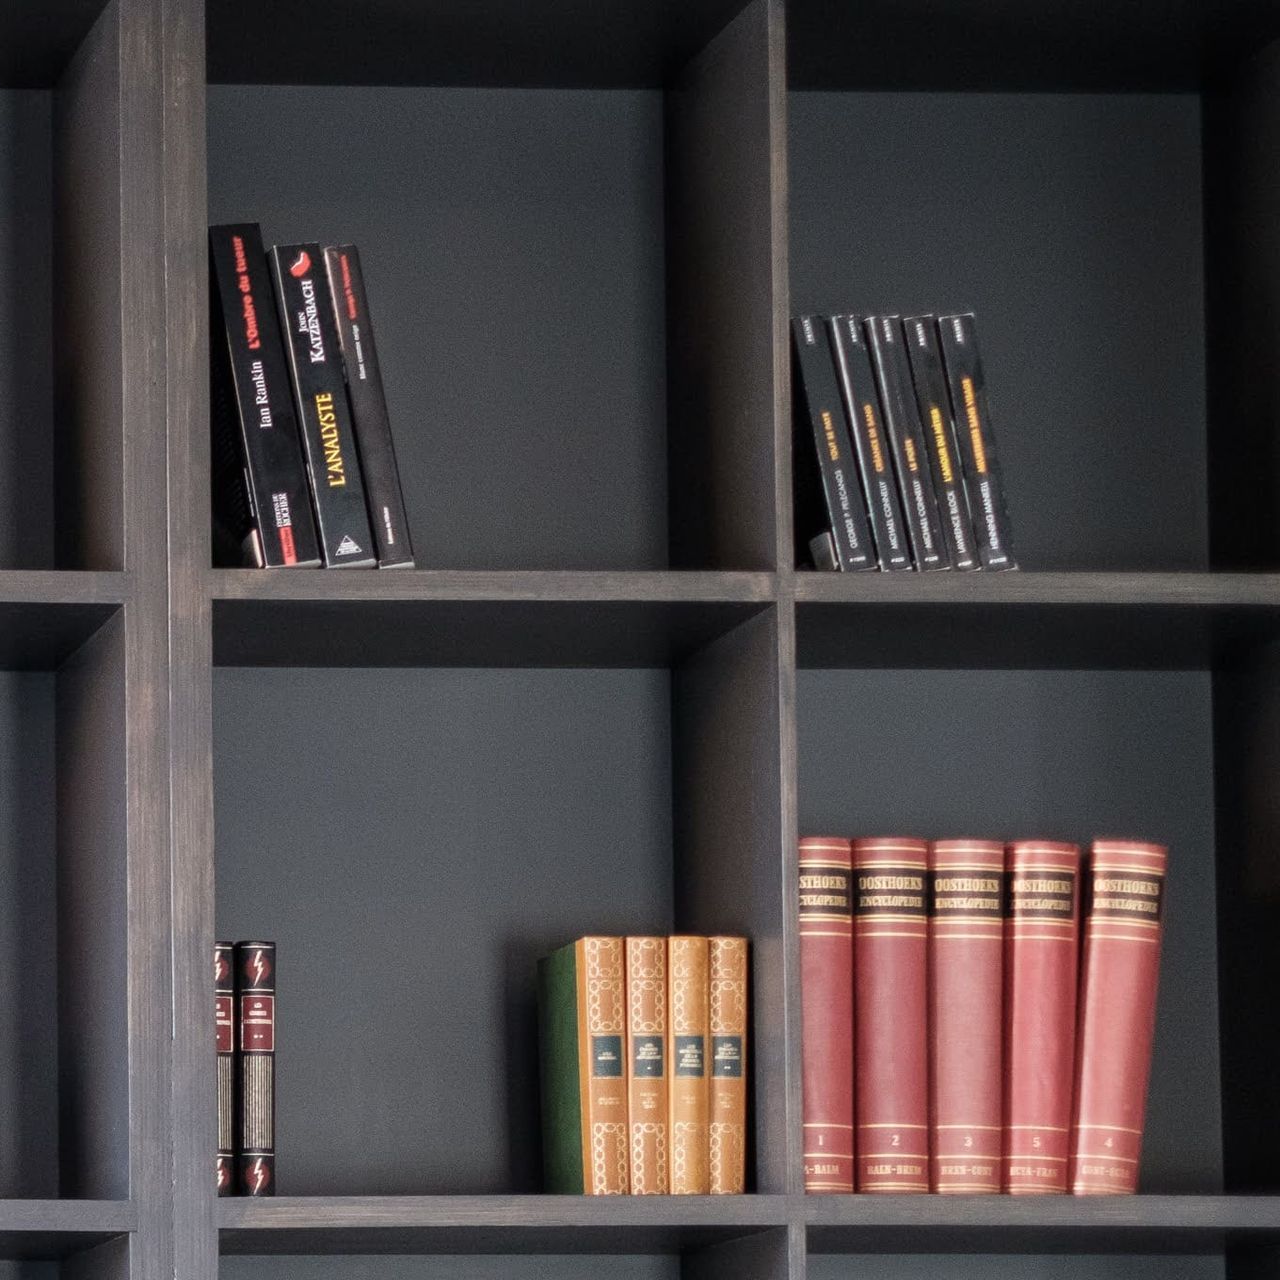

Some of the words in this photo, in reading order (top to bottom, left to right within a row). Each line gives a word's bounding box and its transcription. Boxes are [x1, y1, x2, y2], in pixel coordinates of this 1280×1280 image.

[231, 235, 247, 272] tueur
[237, 275, 250, 292] du
[240, 294, 261, 349] L'Ombre
[299, 279, 325, 362] KATZENBACH
[249, 360, 268, 404] Rankin
[257, 407, 272, 428] Ian
[315, 392, 345, 486] L'ANALYSTE
[878, 480, 892, 517] CONNELLY
[946, 490, 958, 514] BLOCK
[885, 518, 898, 549] MICHAEL
[950, 514, 966, 553] LAWRENCE
[859, 876, 922, 890] OOSTHOEKS
[819, 1135, 824, 1146] 1
[892, 1135, 899, 1146] 2
[964, 1137, 972, 1148] 3
[1032, 1137, 1040, 1148] 5
[1104, 1137, 1113, 1148] 4
